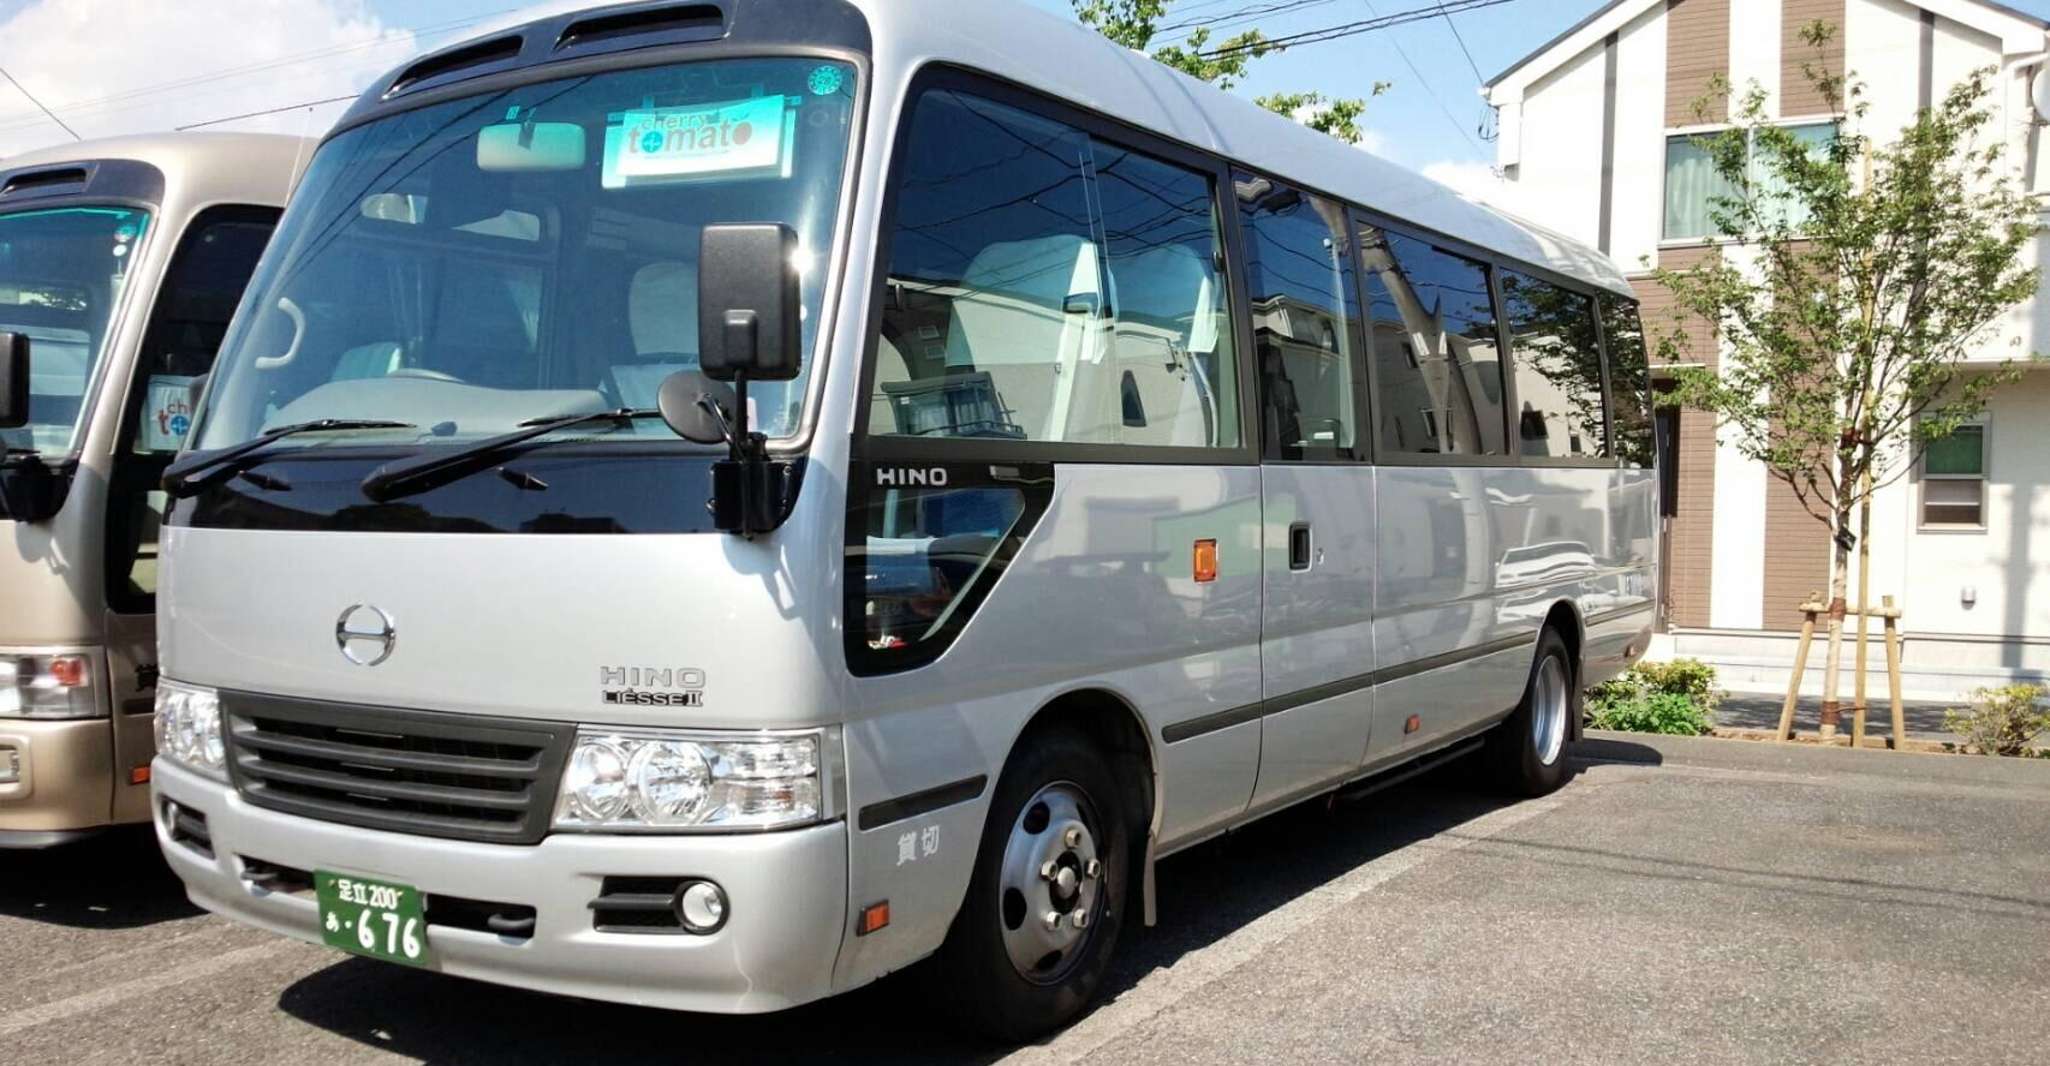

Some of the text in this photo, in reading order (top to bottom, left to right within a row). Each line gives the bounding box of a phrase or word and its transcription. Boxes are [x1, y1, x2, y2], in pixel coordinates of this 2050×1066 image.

[641, 112, 705, 129] cherry
[628, 118, 753, 154] tomato
[877, 468, 947, 486] HINO
[600, 666, 706, 688] HINO
